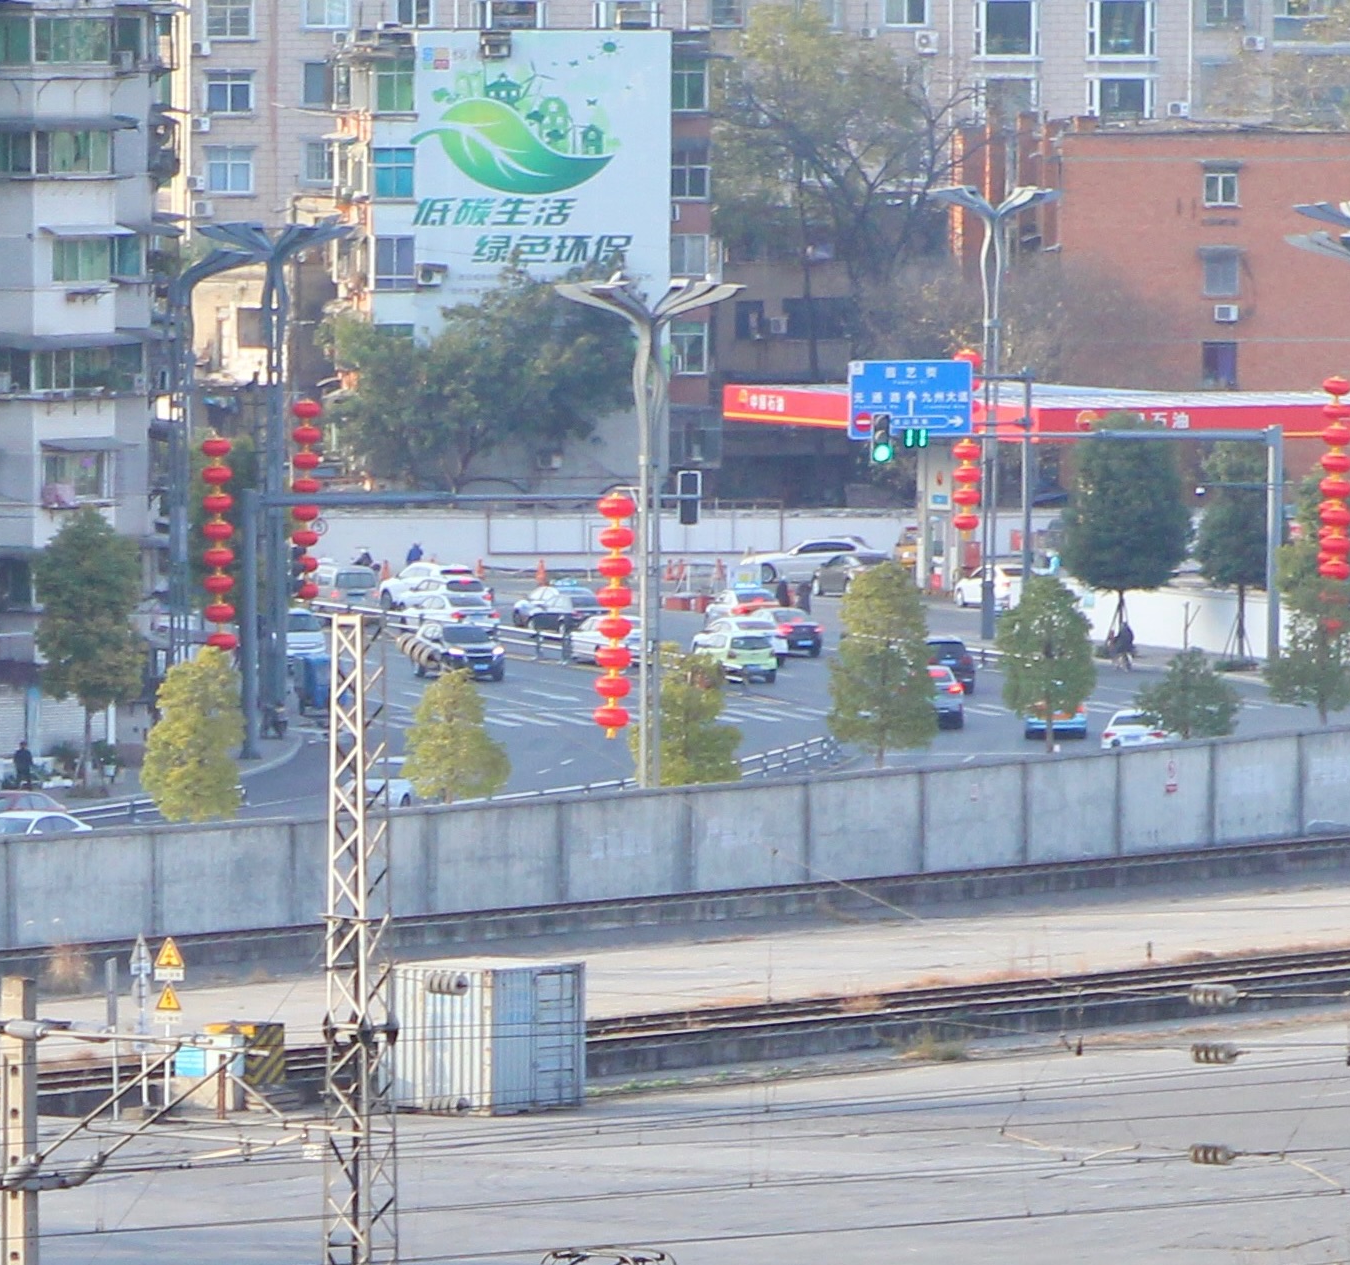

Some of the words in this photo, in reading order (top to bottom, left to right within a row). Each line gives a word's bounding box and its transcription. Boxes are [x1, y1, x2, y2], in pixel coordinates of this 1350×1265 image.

[412, 197, 578, 226] 低碳生活
[471, 234, 633, 263] 绿色环保
